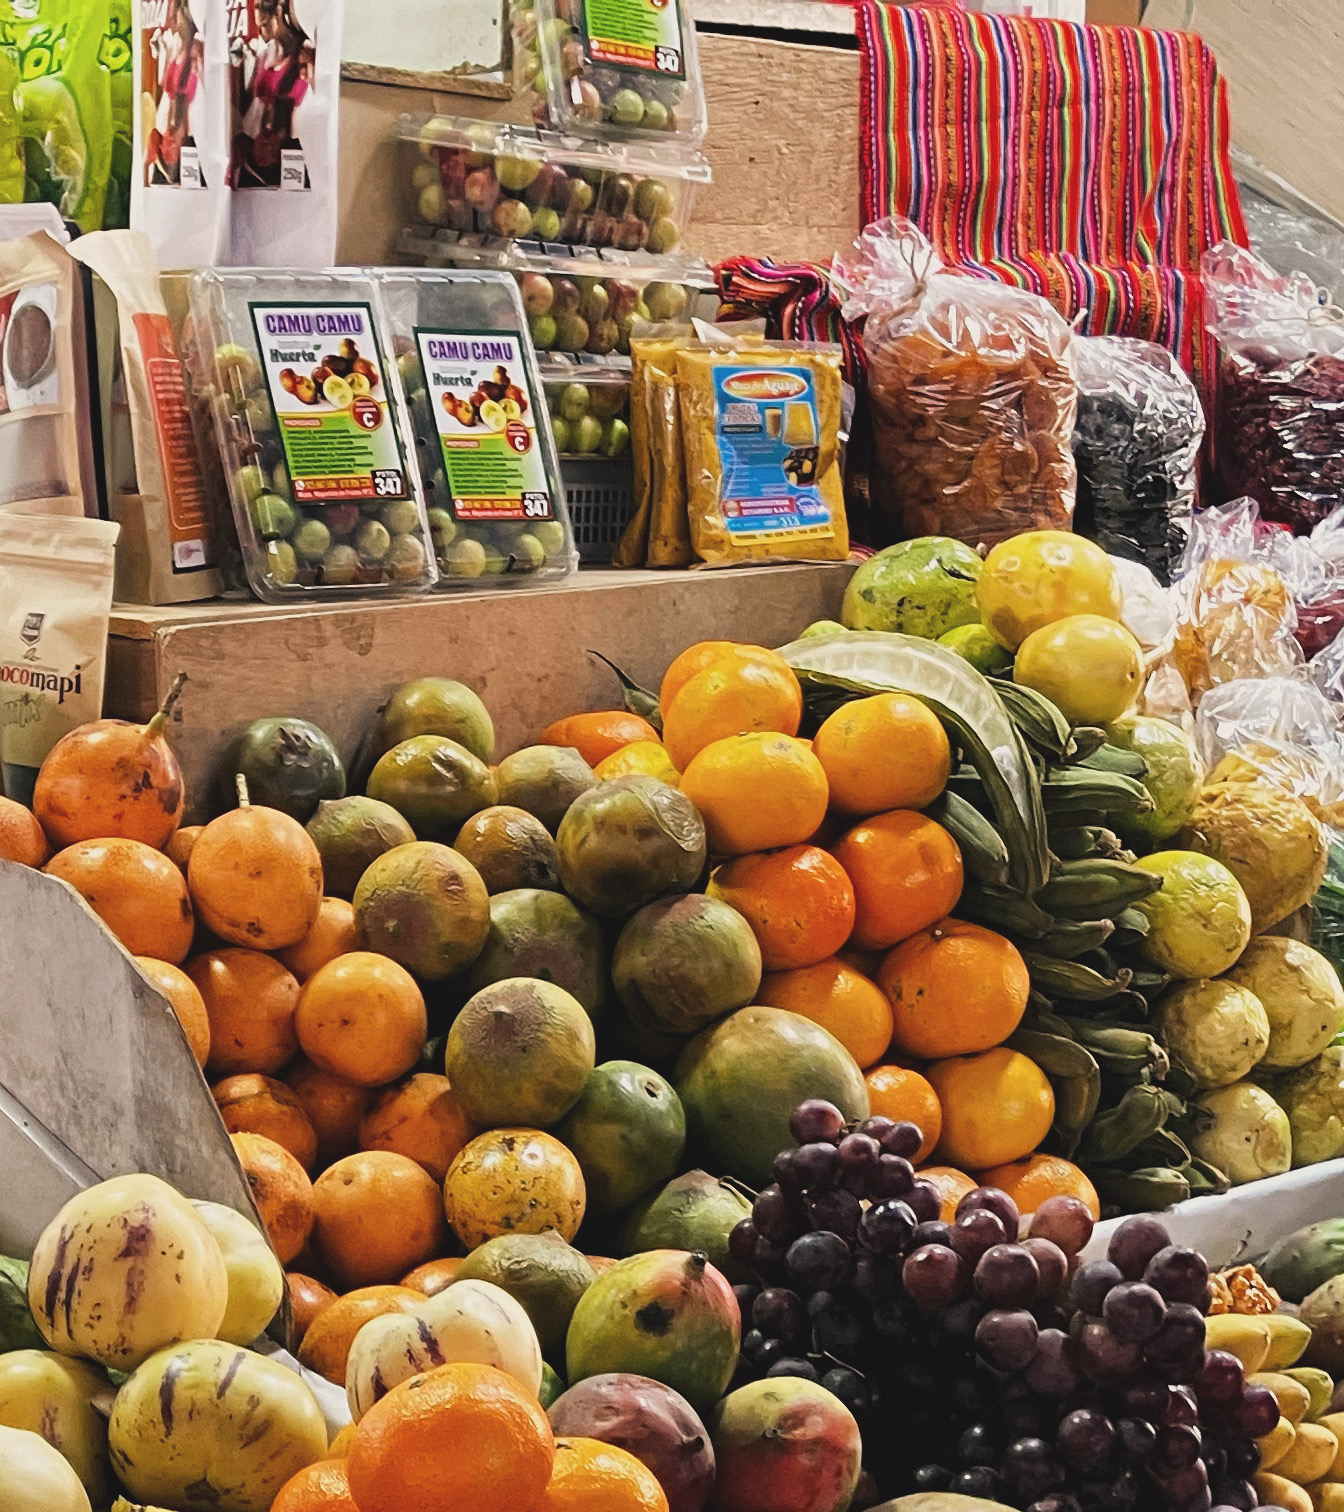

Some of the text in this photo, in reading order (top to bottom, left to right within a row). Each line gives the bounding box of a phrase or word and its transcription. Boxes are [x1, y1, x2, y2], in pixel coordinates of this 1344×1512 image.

[266, 312, 363, 335] CAMU CAMU
[269, 348, 317, 364] Huerta
[428, 339, 514, 362] CAMU CAMU
[432, 372, 473, 388] Huerta
[374, 477, 402, 496] 347
[524, 499, 549, 518] 347
